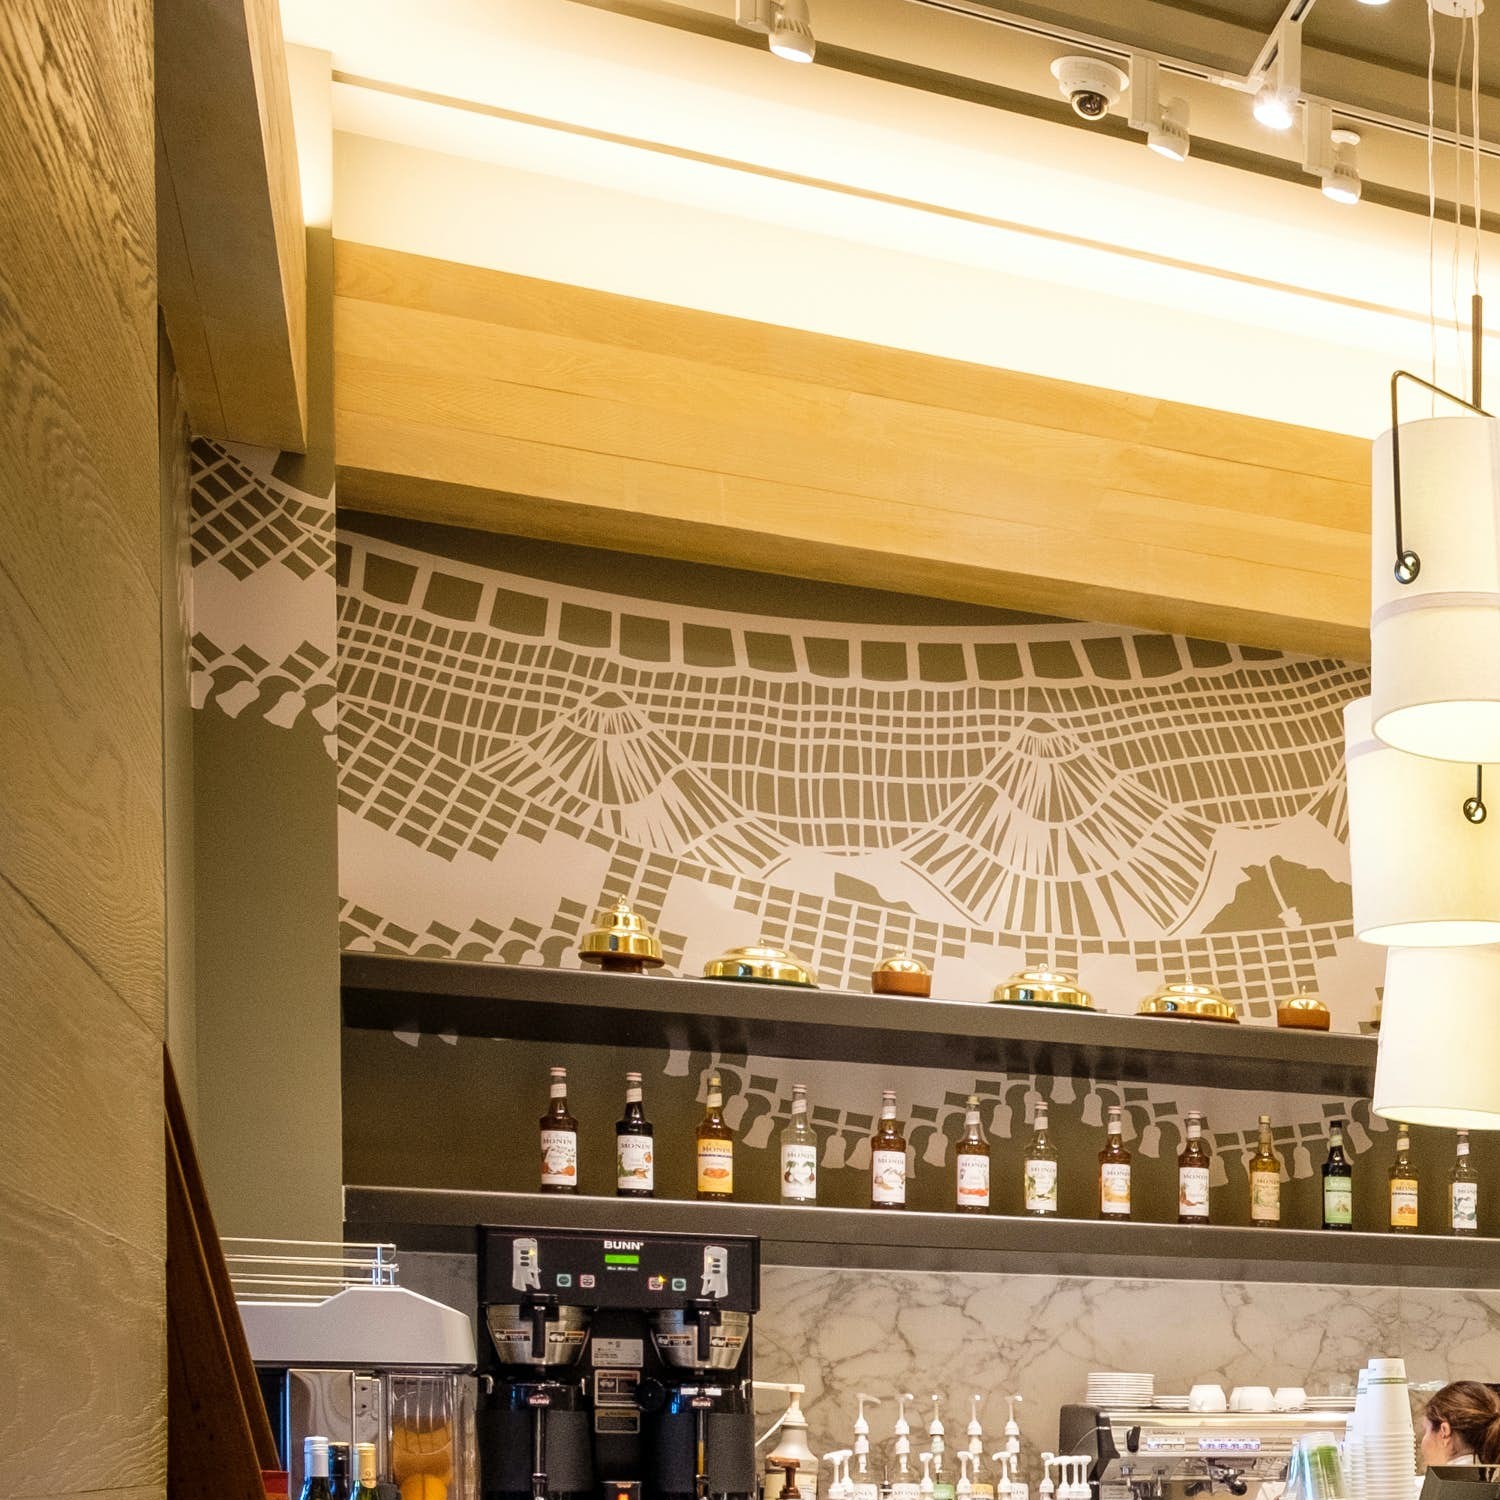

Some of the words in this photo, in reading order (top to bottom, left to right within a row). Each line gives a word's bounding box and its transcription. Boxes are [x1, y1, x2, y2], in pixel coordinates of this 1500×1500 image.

[604, 1240, 642, 1250] BUNN
[529, 1398, 550, 1406] BUNN
[692, 1399, 711, 1407] BUNN
